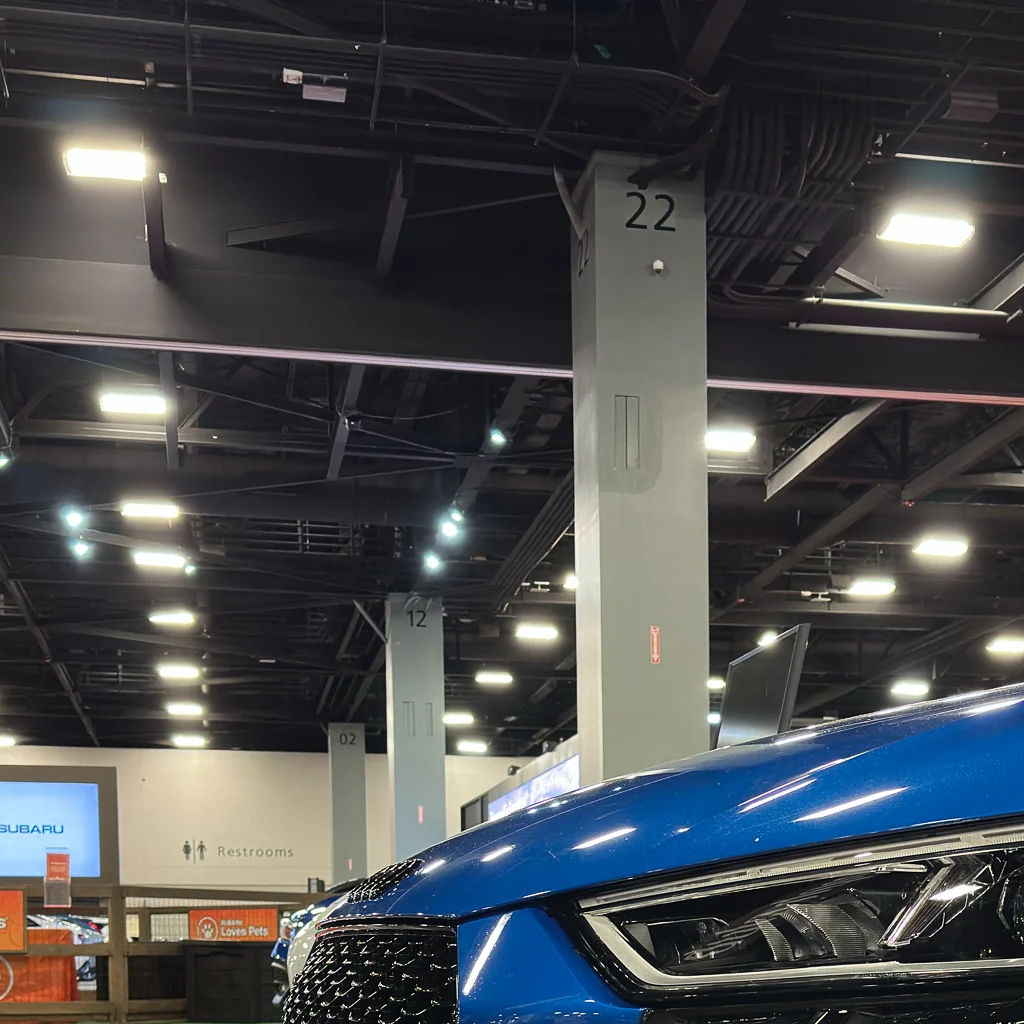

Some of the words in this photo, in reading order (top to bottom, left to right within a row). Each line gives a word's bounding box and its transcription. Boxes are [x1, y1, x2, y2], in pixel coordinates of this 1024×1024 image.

[625, 191, 676, 232] 22
[407, 610, 427, 628] 12
[339, 732, 356, 746] 02
[0, 824, 64, 834] SUBARU
[217, 845, 294, 858] Restrooms
[221, 926, 247, 937] Loves
[248, 925, 269, 937] Pets
